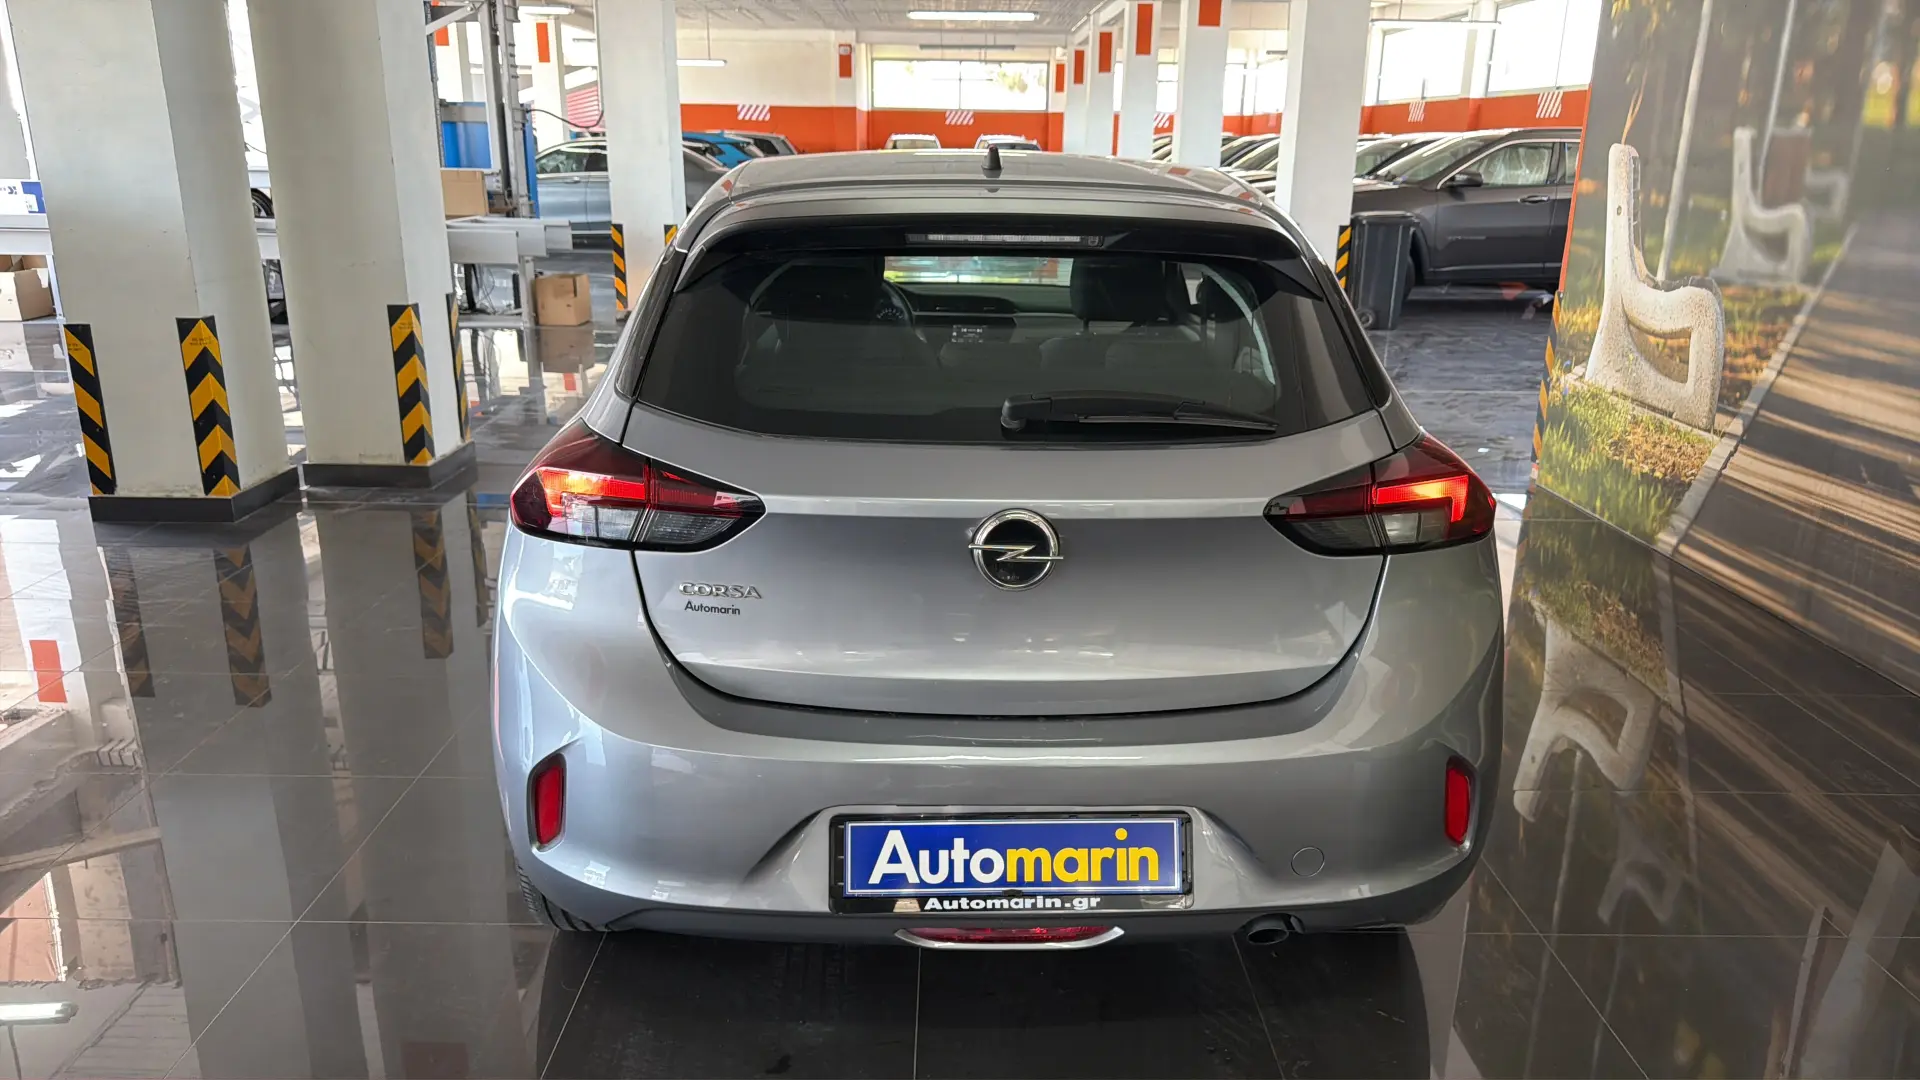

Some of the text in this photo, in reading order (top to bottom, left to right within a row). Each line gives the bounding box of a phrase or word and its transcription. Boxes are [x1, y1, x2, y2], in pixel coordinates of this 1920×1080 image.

[678, 582, 763, 599] CORSA
[684, 600, 741, 615] Automarin
[868, 828, 1160, 885] Automarin
[923, 896, 1101, 911] Automarin.gr
